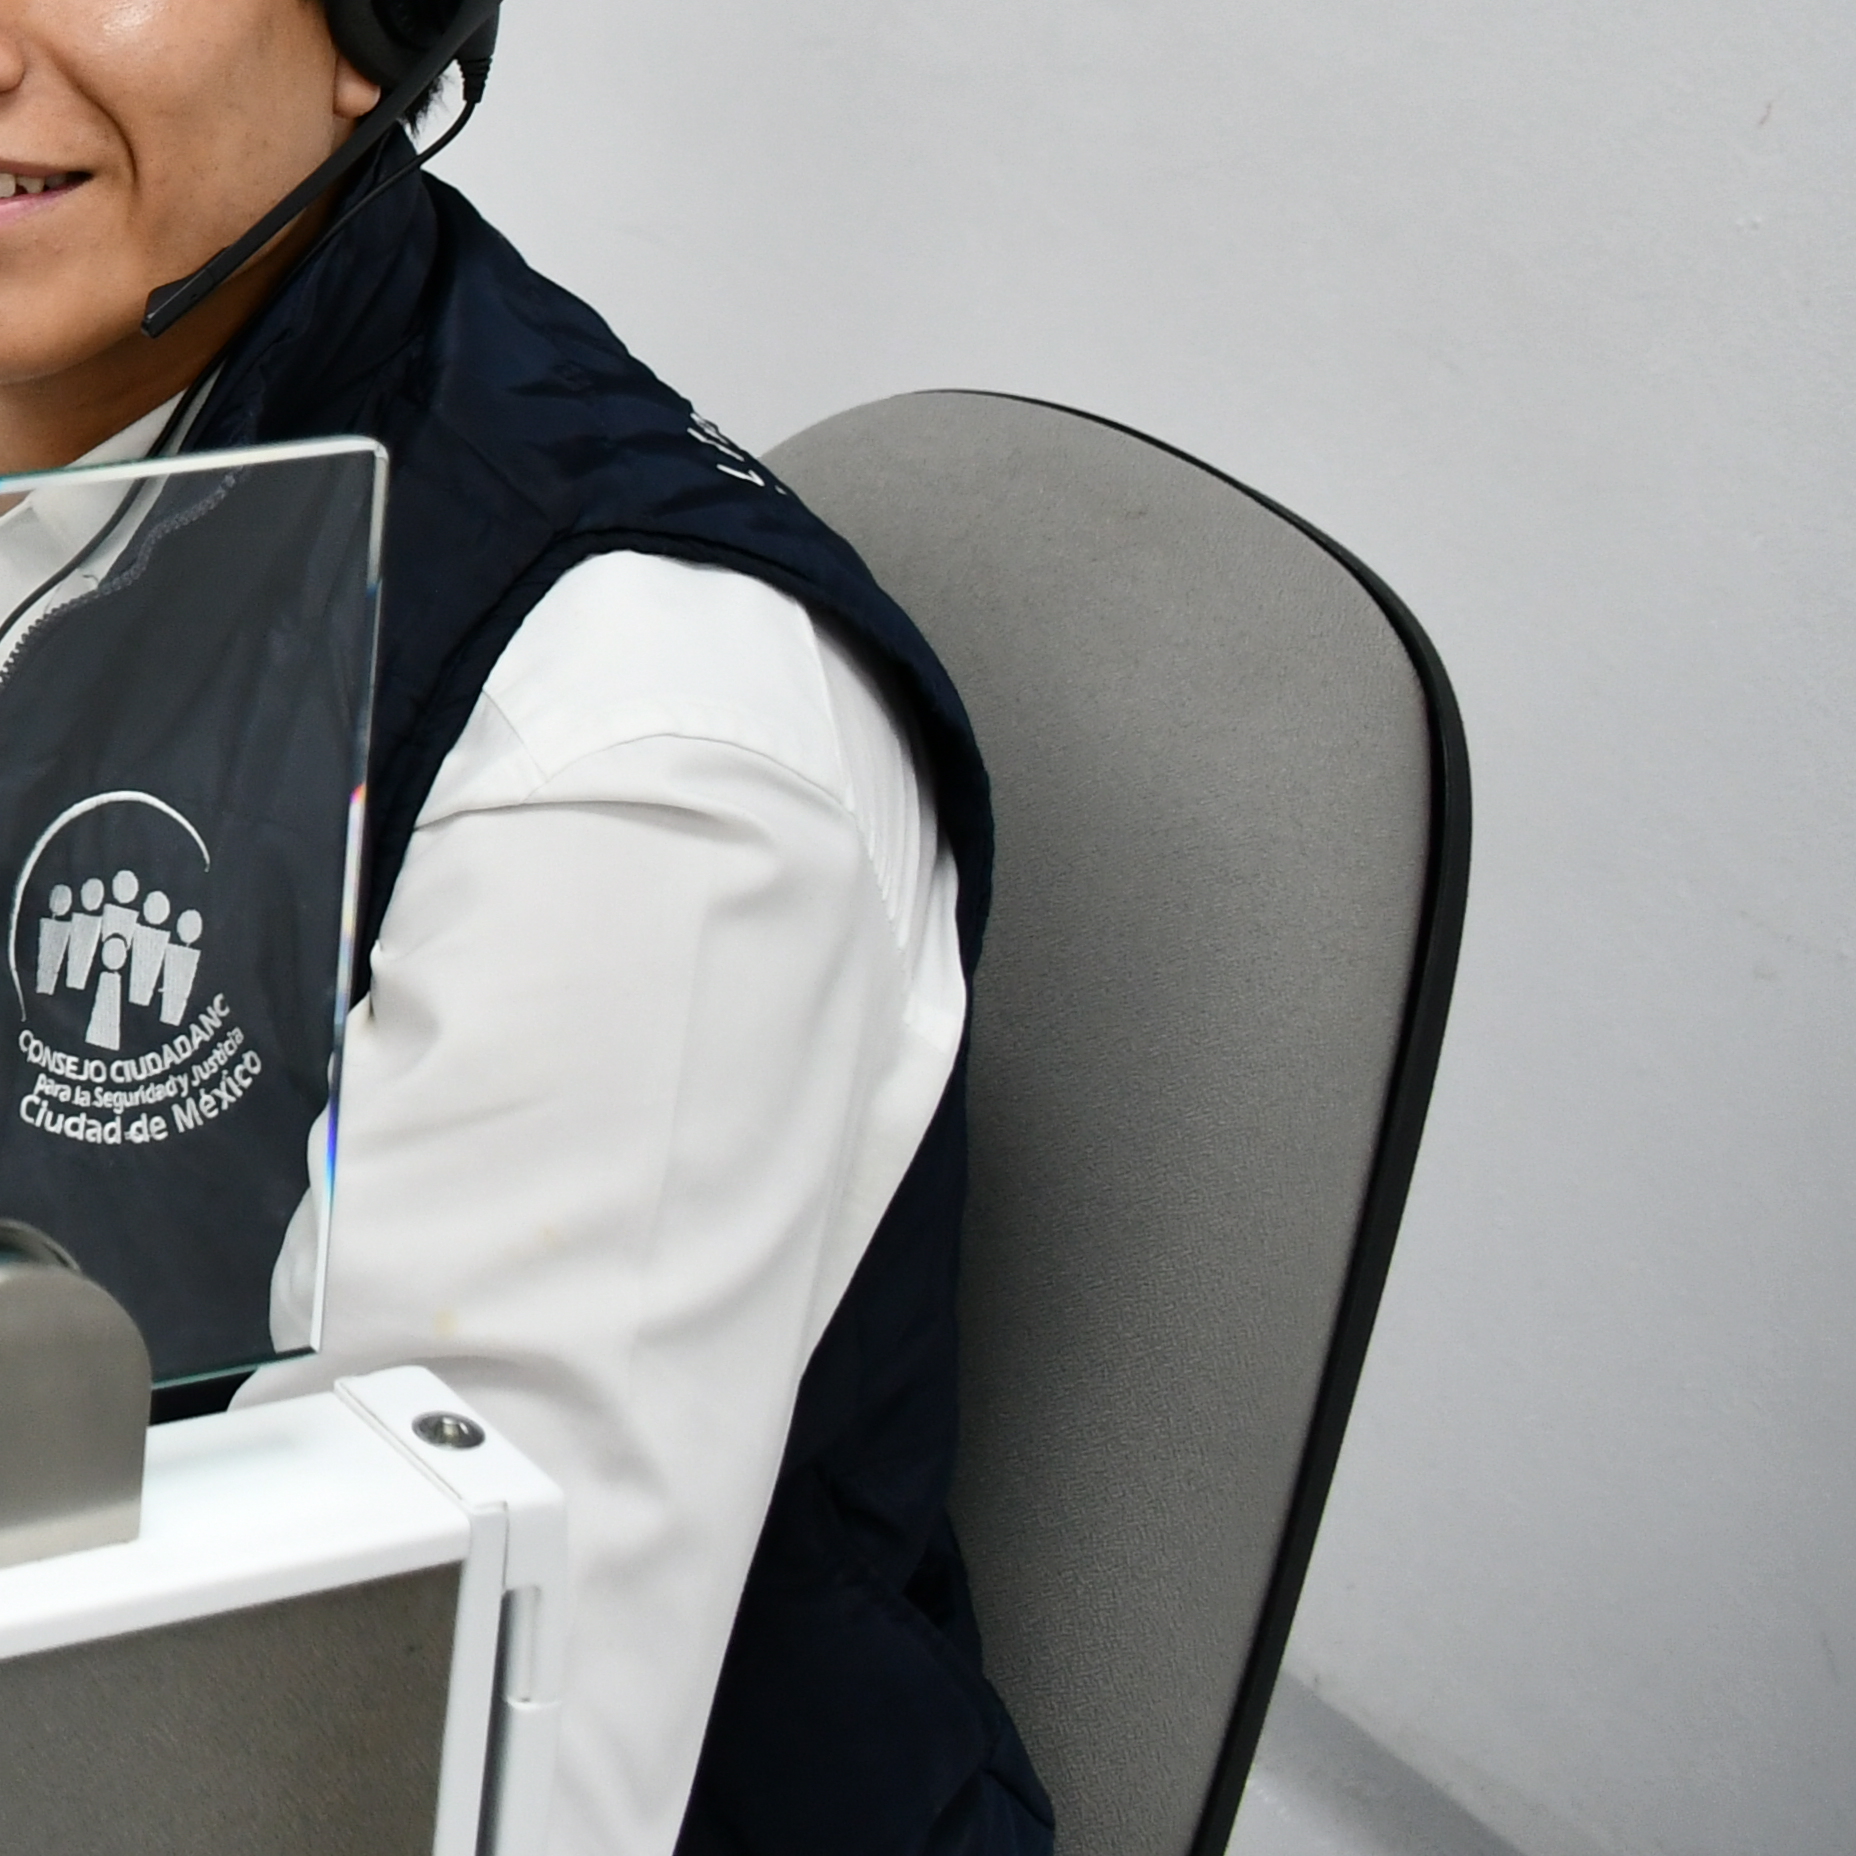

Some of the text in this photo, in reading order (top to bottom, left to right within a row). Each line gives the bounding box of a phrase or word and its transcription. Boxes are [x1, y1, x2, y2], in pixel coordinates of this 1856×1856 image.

[19, 1029, 107, 1083] CONSEJO
[20, 1050, 261, 1144] Ciudad de México
[33, 1073, 72, 1103] para
[73, 1085, 91, 1107] la
[92, 1074, 178, 1114] Seguridad
[191, 1027, 244, 1087] Justicia
